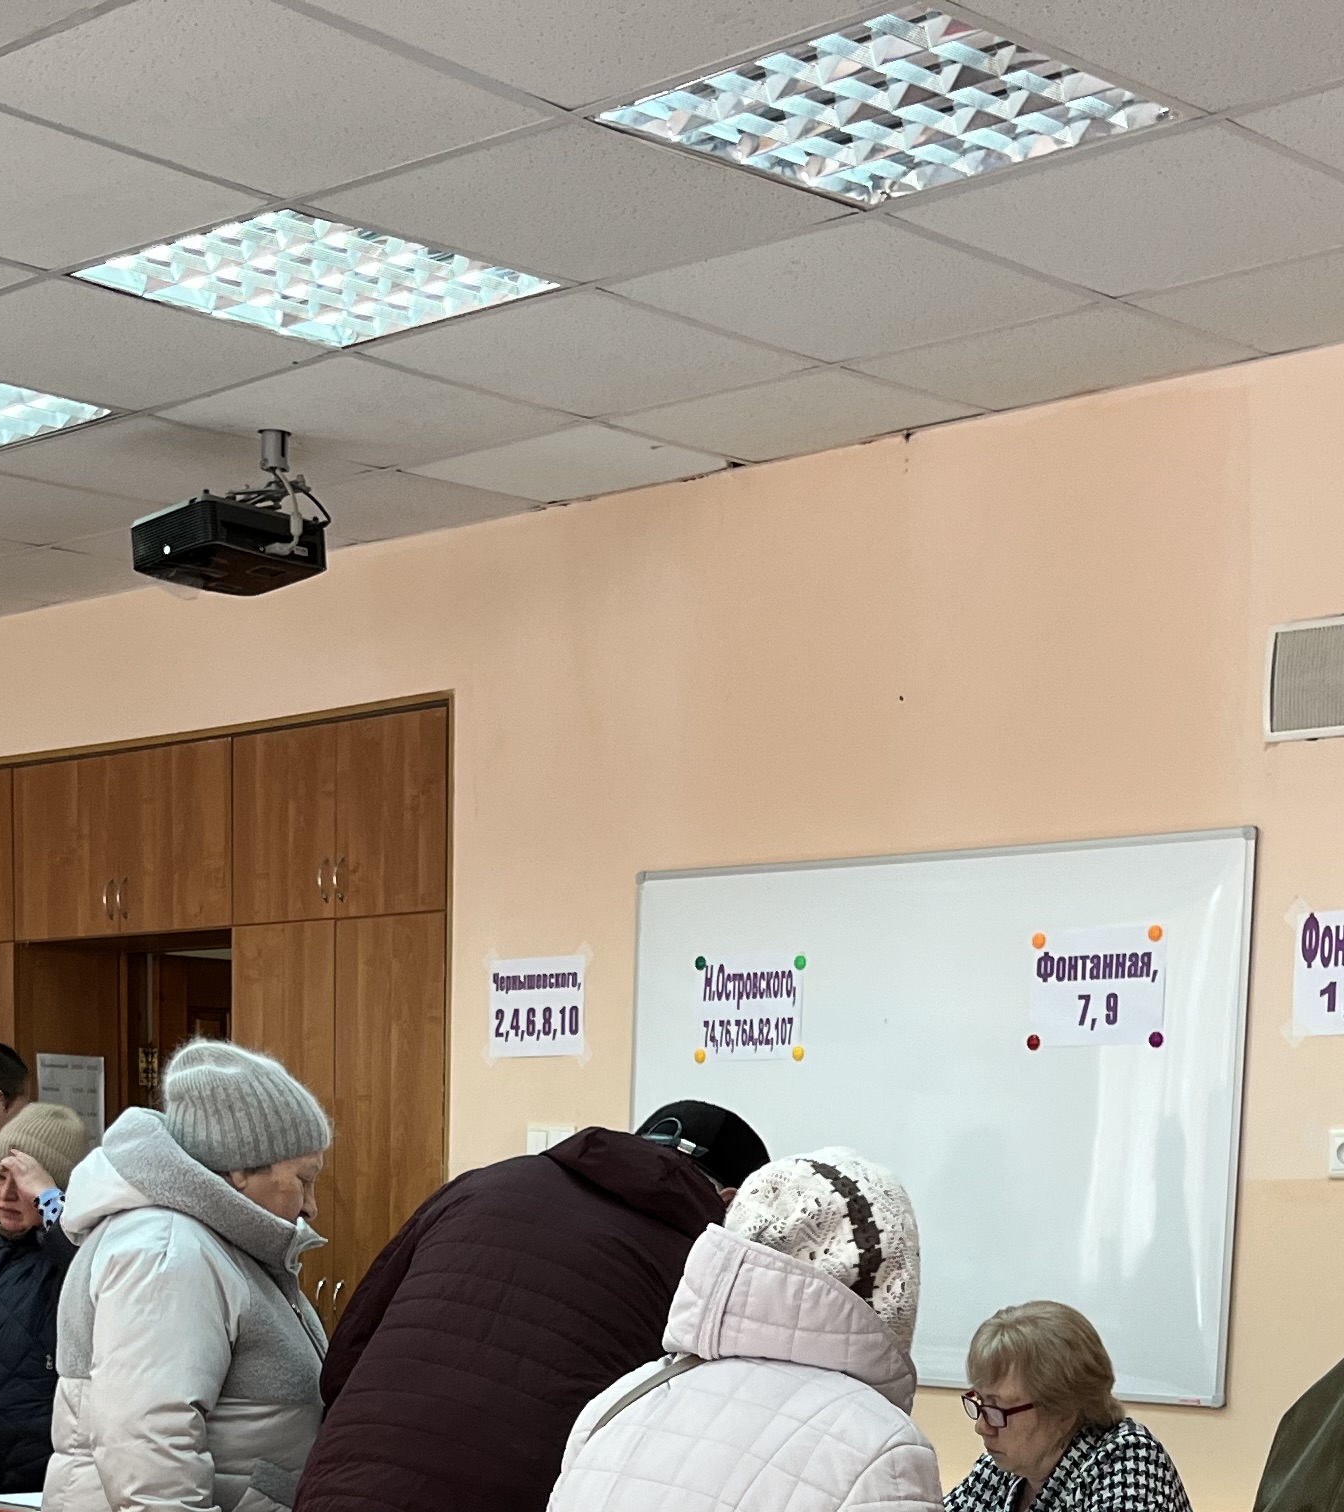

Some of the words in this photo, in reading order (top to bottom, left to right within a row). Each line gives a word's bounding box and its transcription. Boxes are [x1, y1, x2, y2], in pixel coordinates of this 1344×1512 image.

[492, 971, 582, 994] Чернышевского,
[1037, 951, 1158, 983] Фонтанная,
[703, 964, 796, 1010] Н.Островского,
[494, 1005, 579, 1042] 2,4,6,8,10
